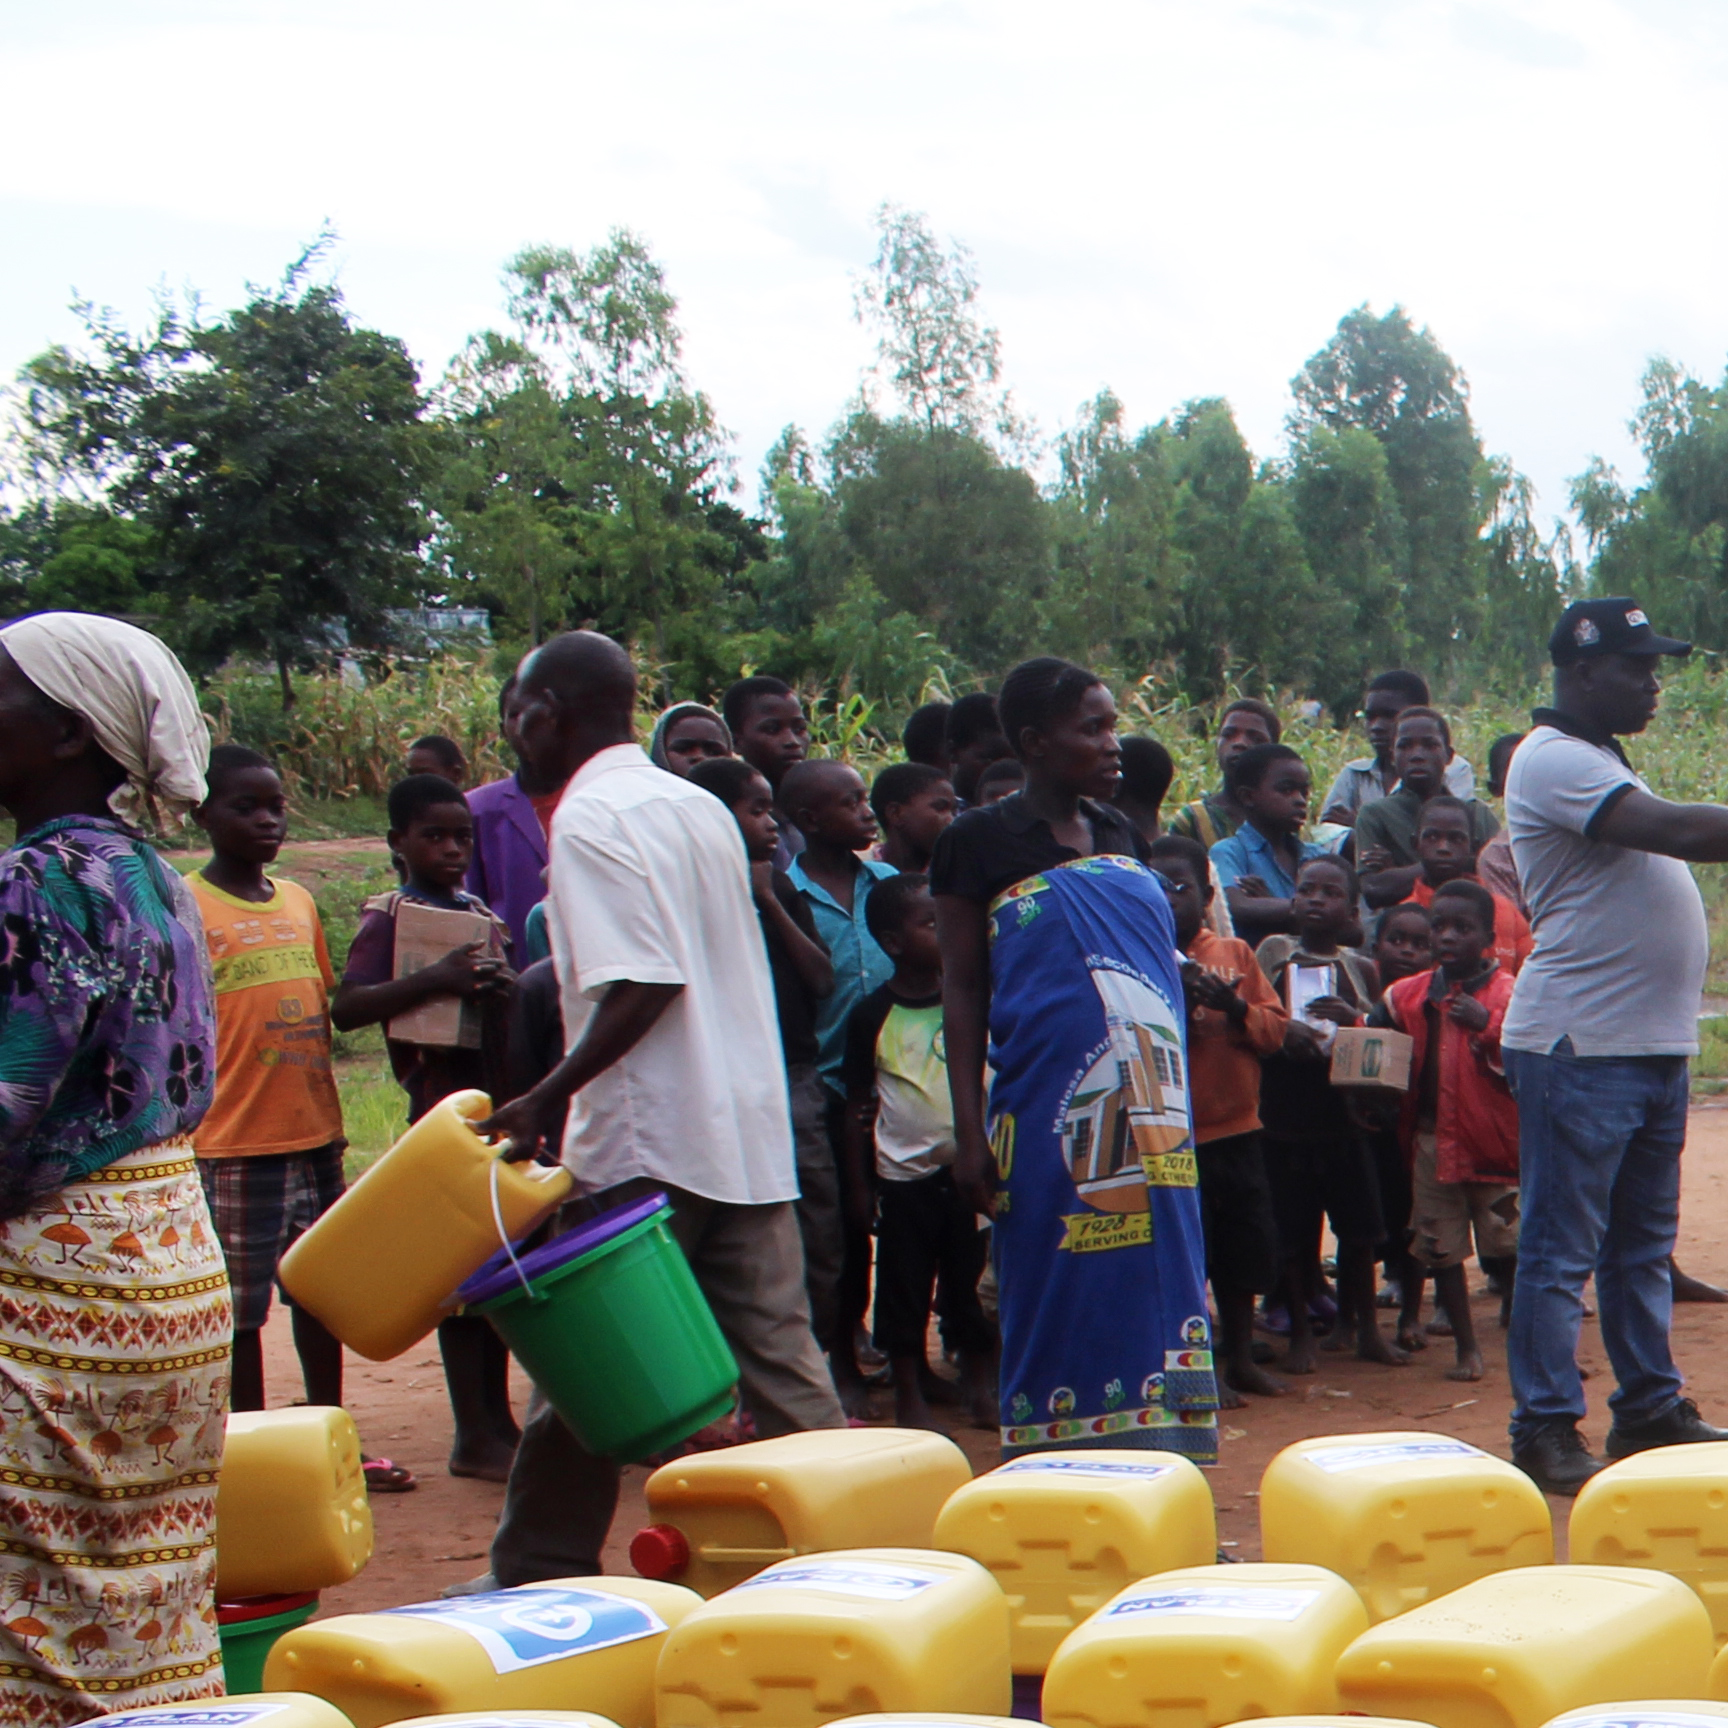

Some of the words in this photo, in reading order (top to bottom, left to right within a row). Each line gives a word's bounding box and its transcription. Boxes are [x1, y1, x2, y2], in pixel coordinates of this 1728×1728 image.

[1053, 1069, 1084, 1134] Malosa
[1163, 1156, 1194, 1170] 2018
[1079, 1214, 1127, 1237] 1928
[1074, 1230, 1139, 1251] SERVING
[128, 1712, 247, 1724] PLAN
